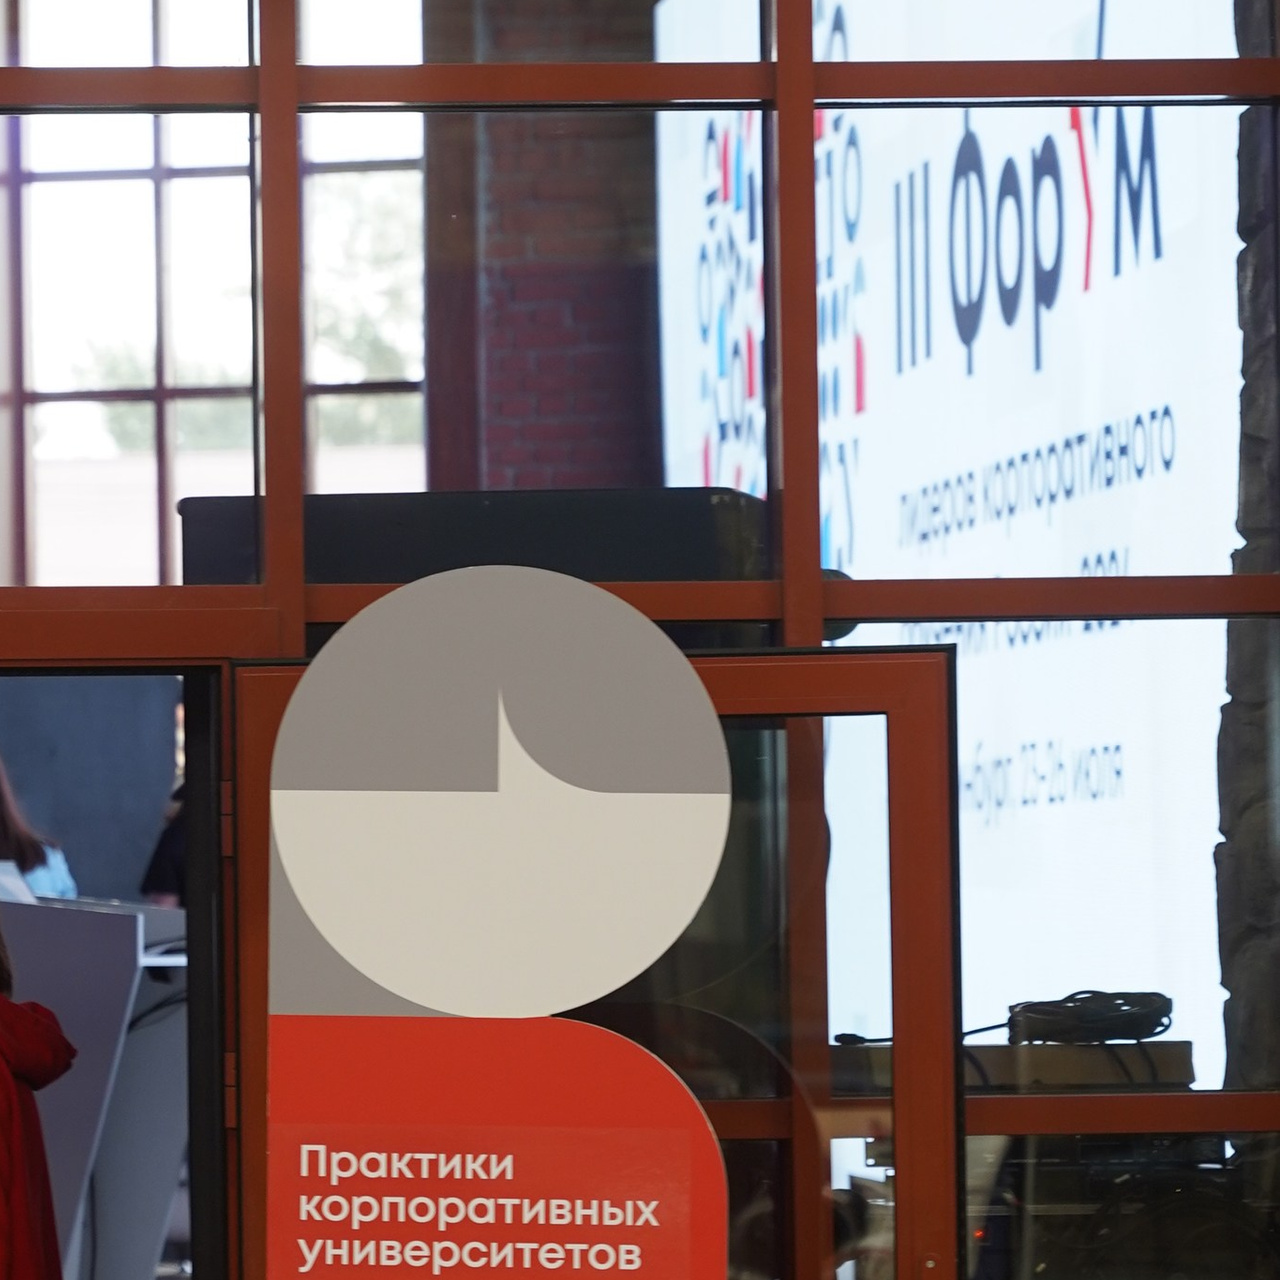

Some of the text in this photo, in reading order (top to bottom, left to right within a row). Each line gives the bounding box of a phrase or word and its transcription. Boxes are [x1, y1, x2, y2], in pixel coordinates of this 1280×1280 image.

[982, 404, 1177, 537] корпоративного
[299, 1144, 515, 1186] Практики
[298, 1194, 661, 1231] корпоративных
[296, 1238, 643, 1275] университетов
